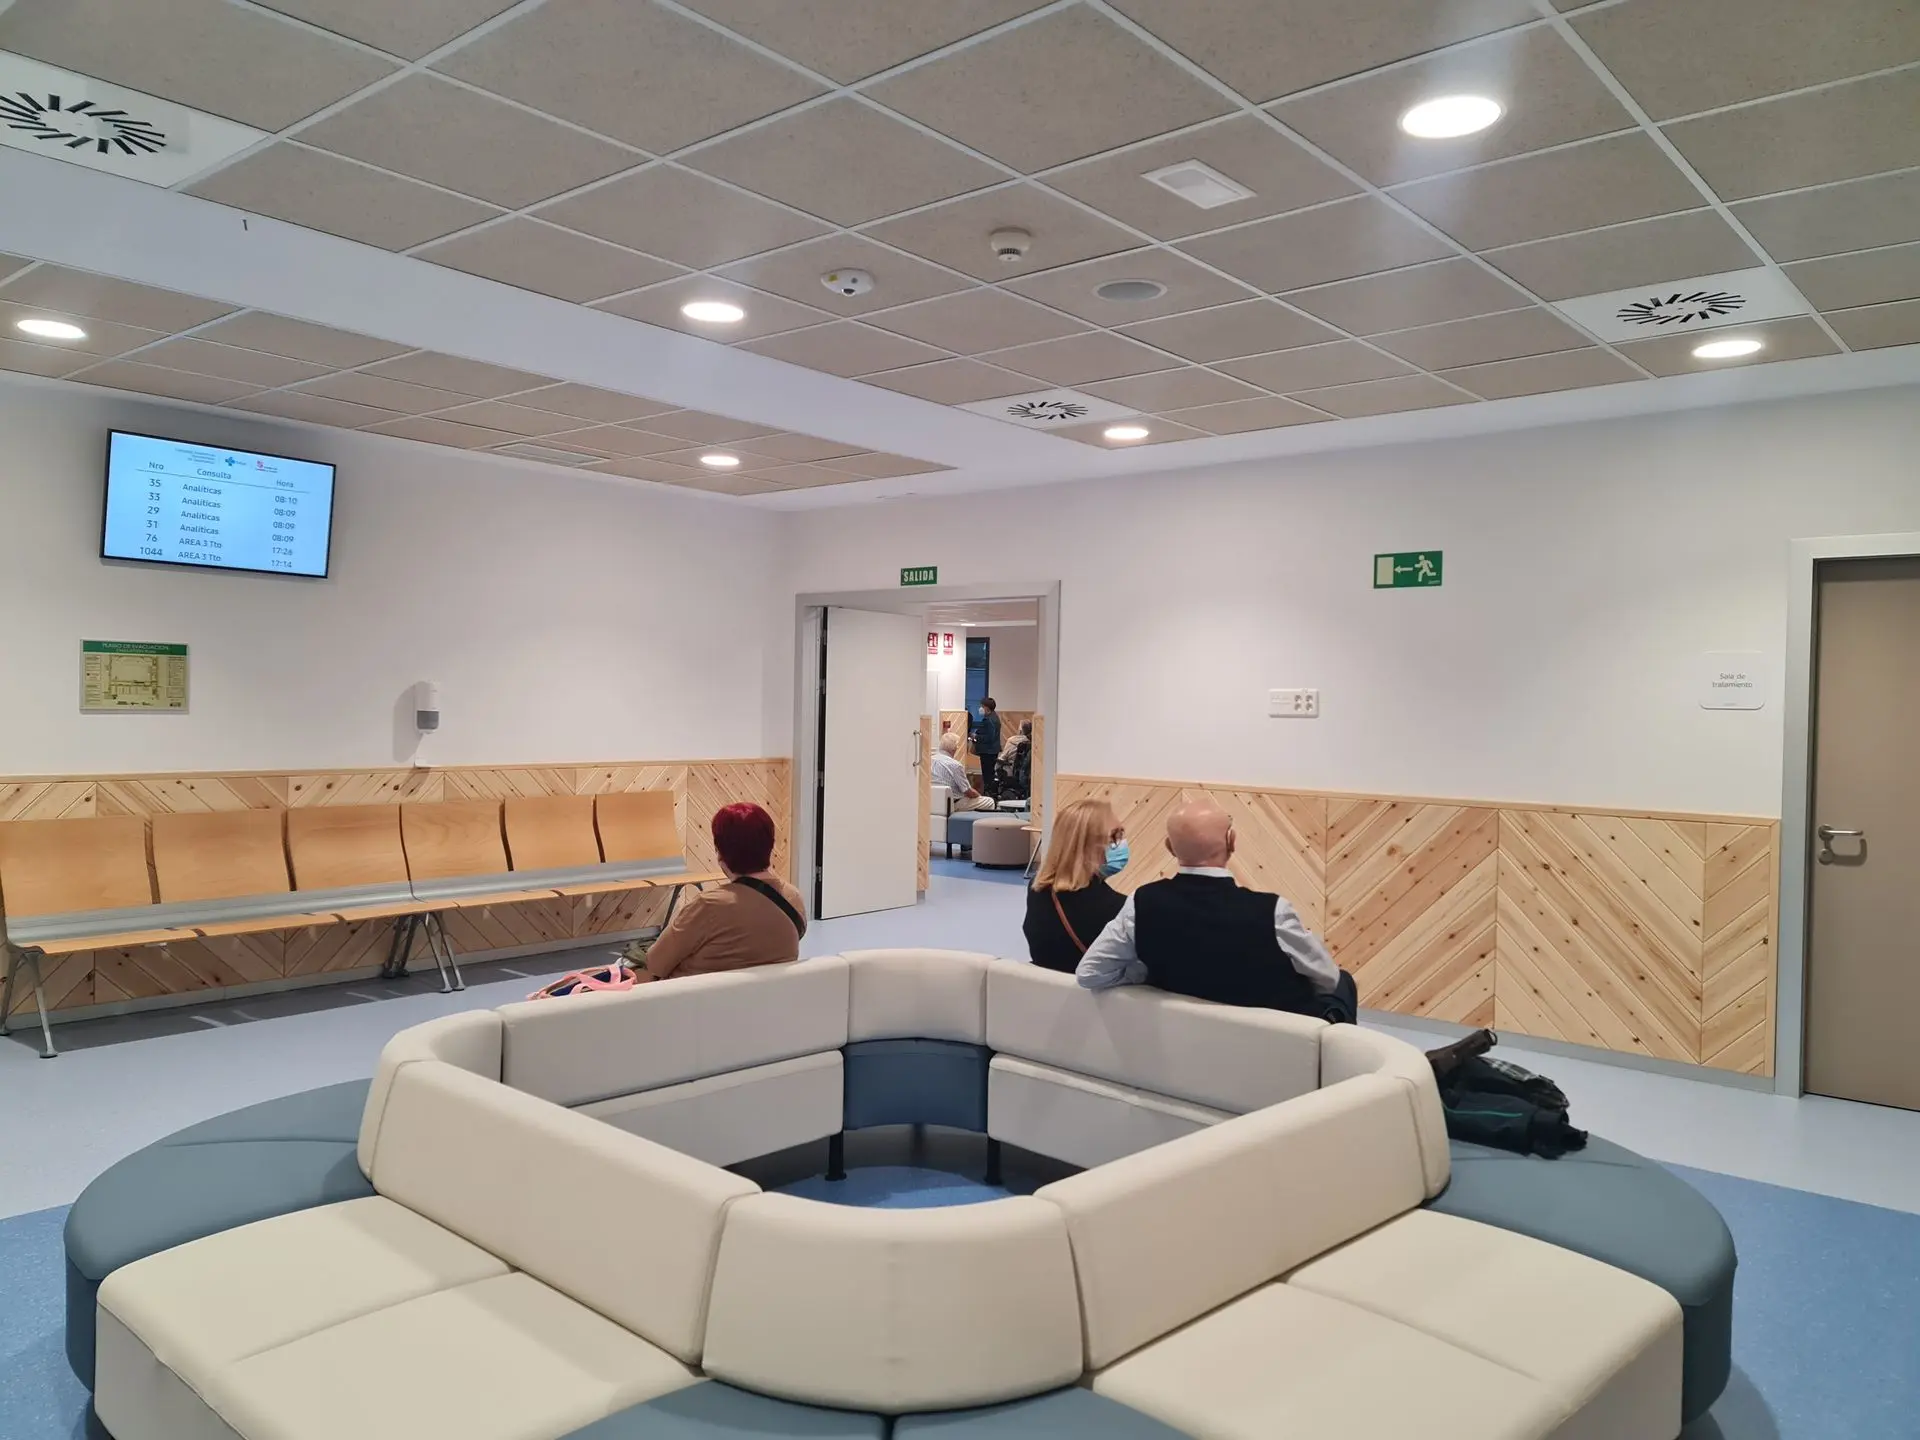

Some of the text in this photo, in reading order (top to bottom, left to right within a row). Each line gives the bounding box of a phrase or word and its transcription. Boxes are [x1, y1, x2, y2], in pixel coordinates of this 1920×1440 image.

[149, 461, 164, 470] Nro
[197, 468, 231, 479] Consulta
[149, 479, 161, 487] 35
[276, 480, 294, 488] Hora
[148, 493, 160, 501] 33
[274, 496, 297, 504] 08:10
[147, 506, 159, 515] 29
[274, 509, 296, 517] 08:09
[147, 520, 158, 529] 31
[273, 522, 295, 530] 08:09
[146, 534, 158, 542] 76
[272, 534, 294, 543] 08:09
[179, 538, 201, 547] AREA
[140, 547, 163, 556] 1044
[178, 552, 200, 560] AREA
[903, 570, 934, 582] SALIDA
[1719, 672, 1746, 680] Sala de
